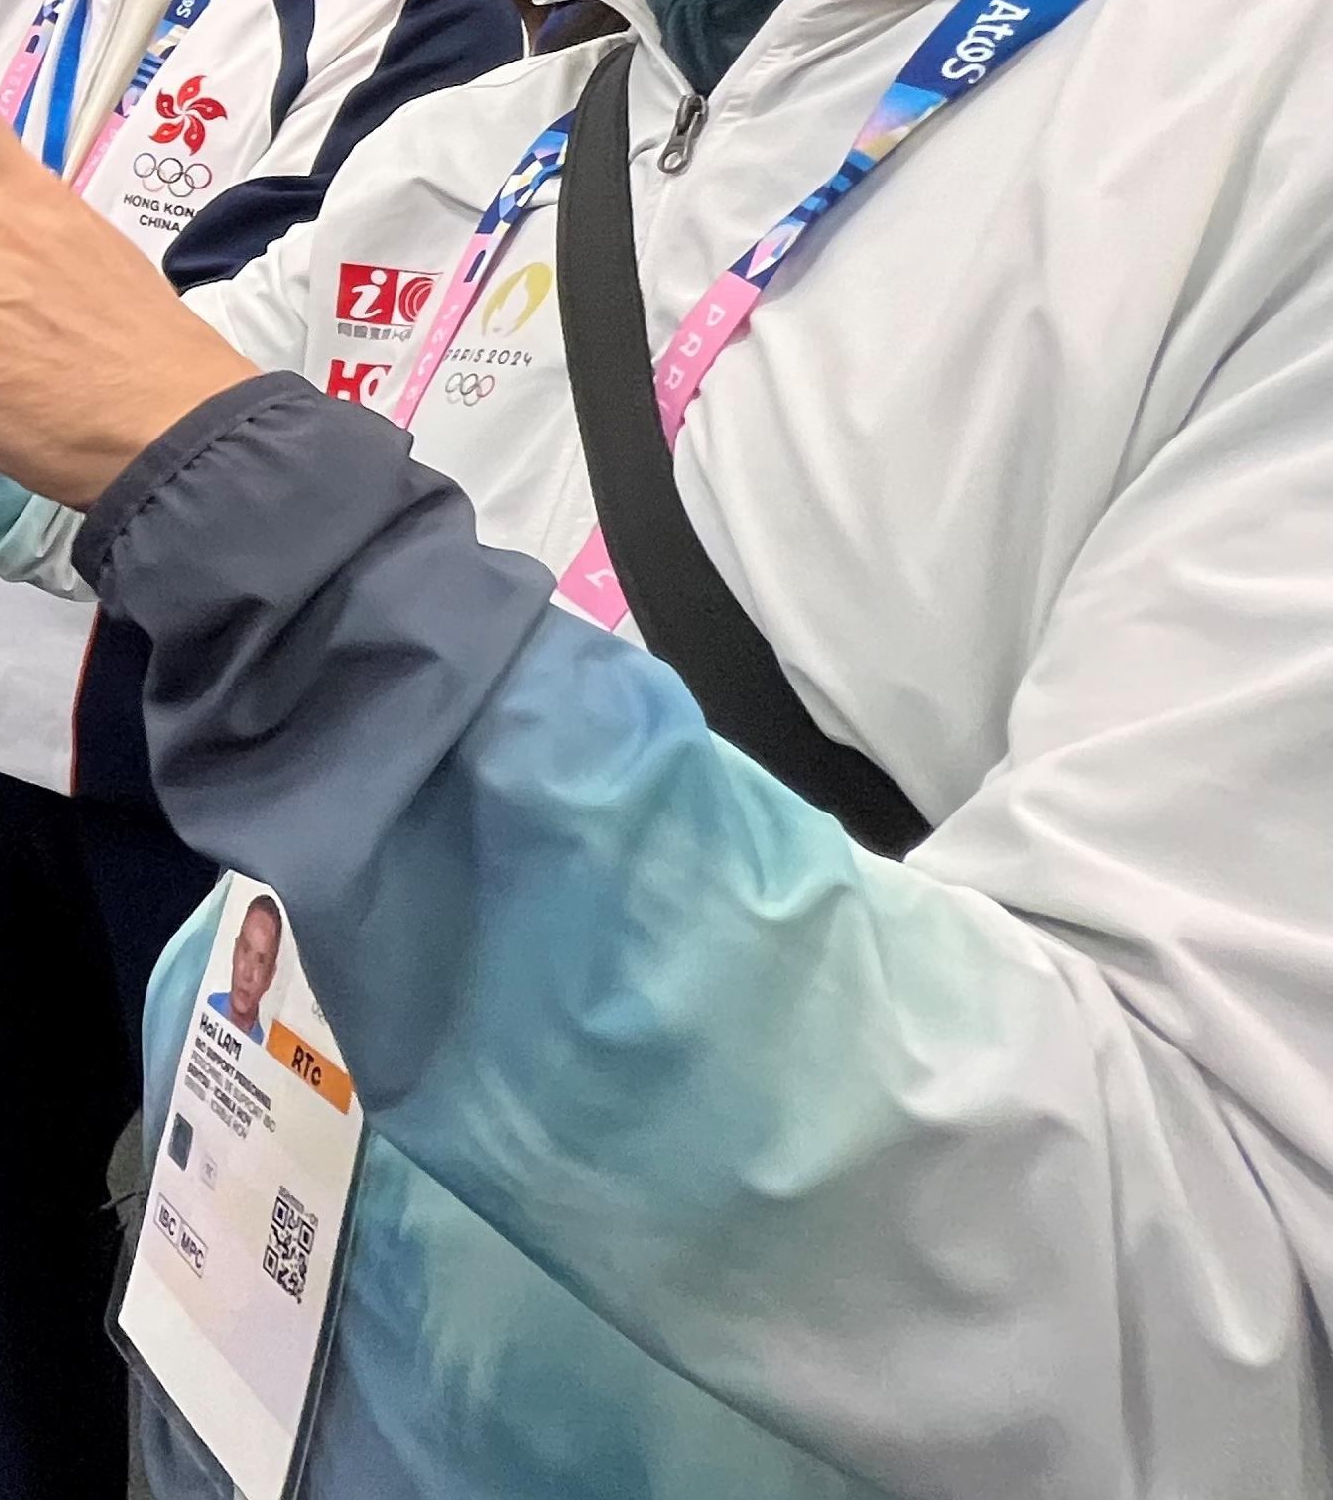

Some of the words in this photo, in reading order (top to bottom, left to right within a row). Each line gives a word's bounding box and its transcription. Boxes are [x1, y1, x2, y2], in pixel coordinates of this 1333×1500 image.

[123, 194, 159, 212] HONG
[163, 203, 195, 218] KON
[139, 214, 181, 233] CHINA
[486, 349, 533, 367] 2024
[200, 1012, 217, 1040] Hai
[217, 1028, 242, 1061] LAM
[291, 1045, 322, 1087] RTC
